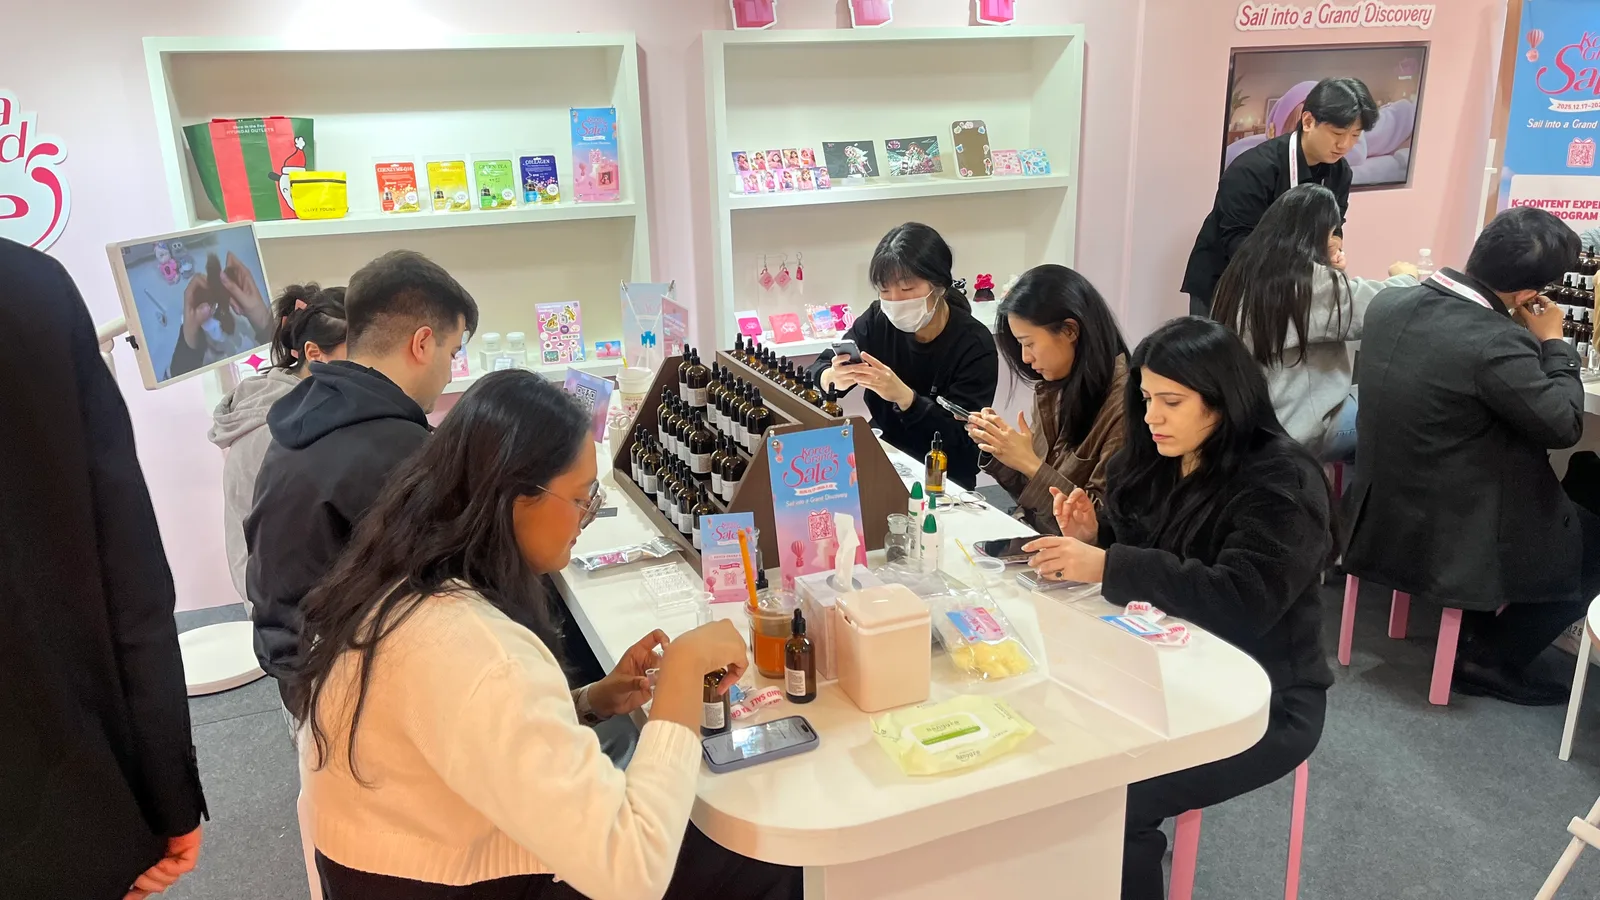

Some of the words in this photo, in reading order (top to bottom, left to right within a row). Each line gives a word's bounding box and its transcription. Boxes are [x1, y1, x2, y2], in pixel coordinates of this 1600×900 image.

[1239, 5, 1269, 26] Sail
[1270, 8, 1299, 25] into
[1303, 10, 1313, 25] a
[1318, 3, 1361, 24] Grand
[1364, 2, 1433, 25] Discovery
[1527, 118, 1543, 128] Sail
[1545, 119, 1561, 128] into
[1572, 118, 1598, 129] Grand
[1511, 199, 1571, 209] K-CONTENT
[801, 445, 831, 458] Korea
[804, 450, 836, 465] Grand
[782, 455, 839, 488] Sale
[751, 693, 766, 707] SALE
